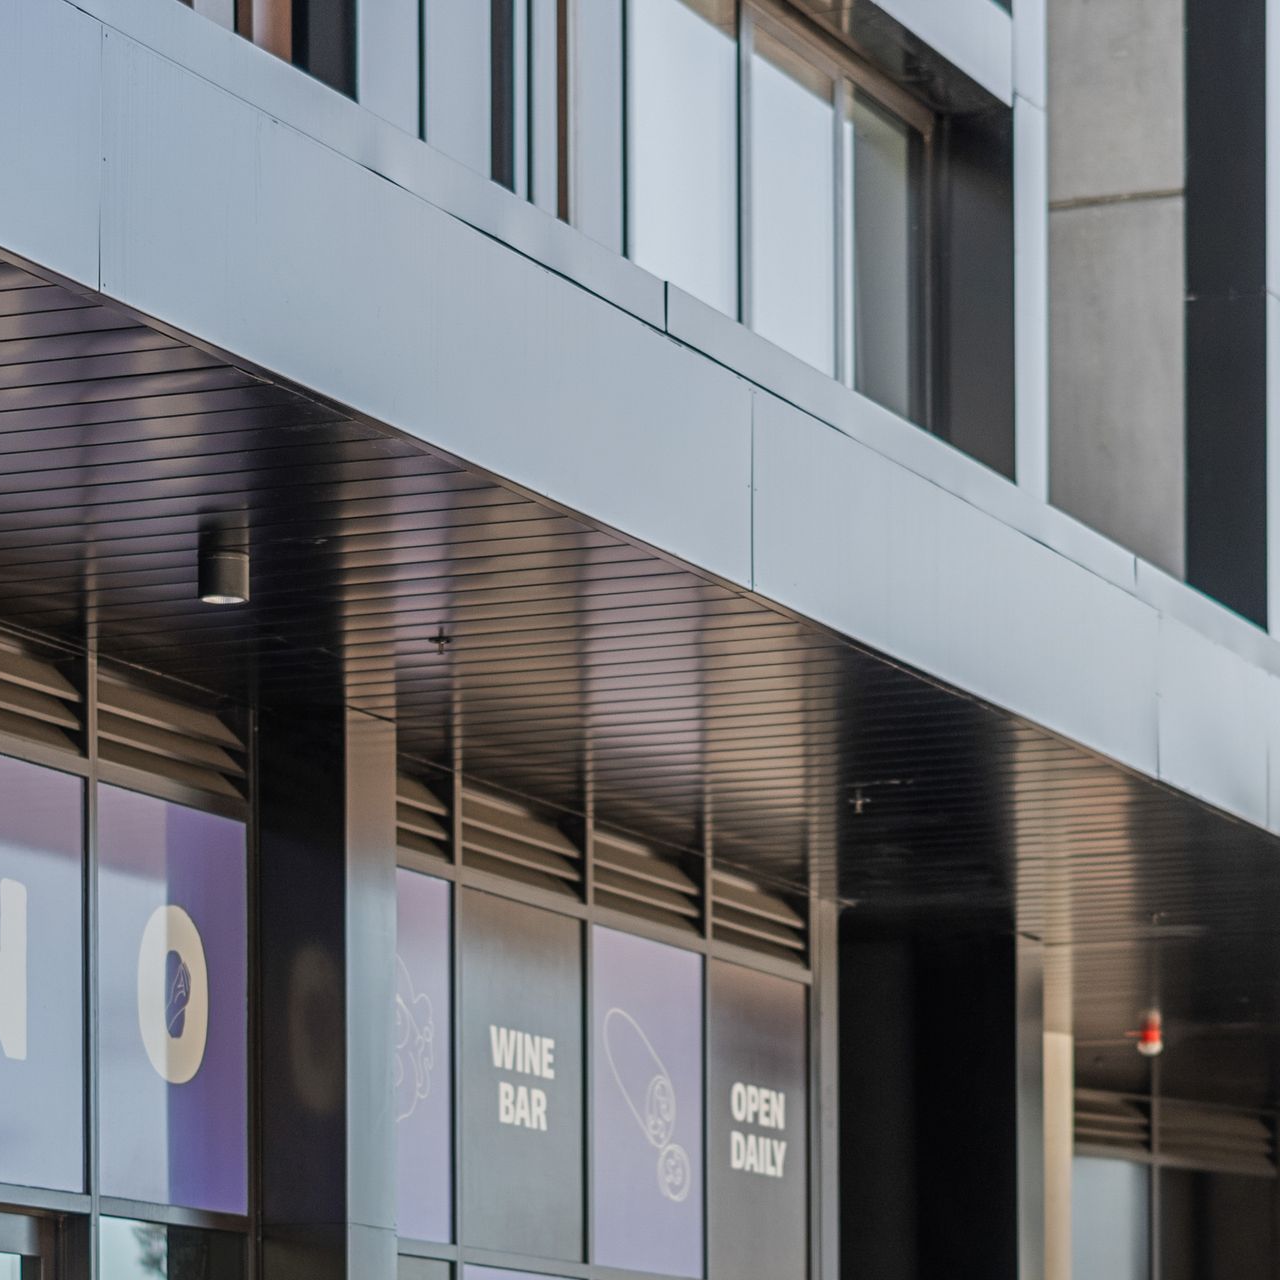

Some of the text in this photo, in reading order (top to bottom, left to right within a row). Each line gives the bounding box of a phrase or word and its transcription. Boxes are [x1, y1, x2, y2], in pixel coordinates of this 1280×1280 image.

[489, 1024, 555, 1079] WINE
[499, 1081, 548, 1131] BAR
[730, 1082, 786, 1130] OPEN
[730, 1131, 787, 1177] DAILY
